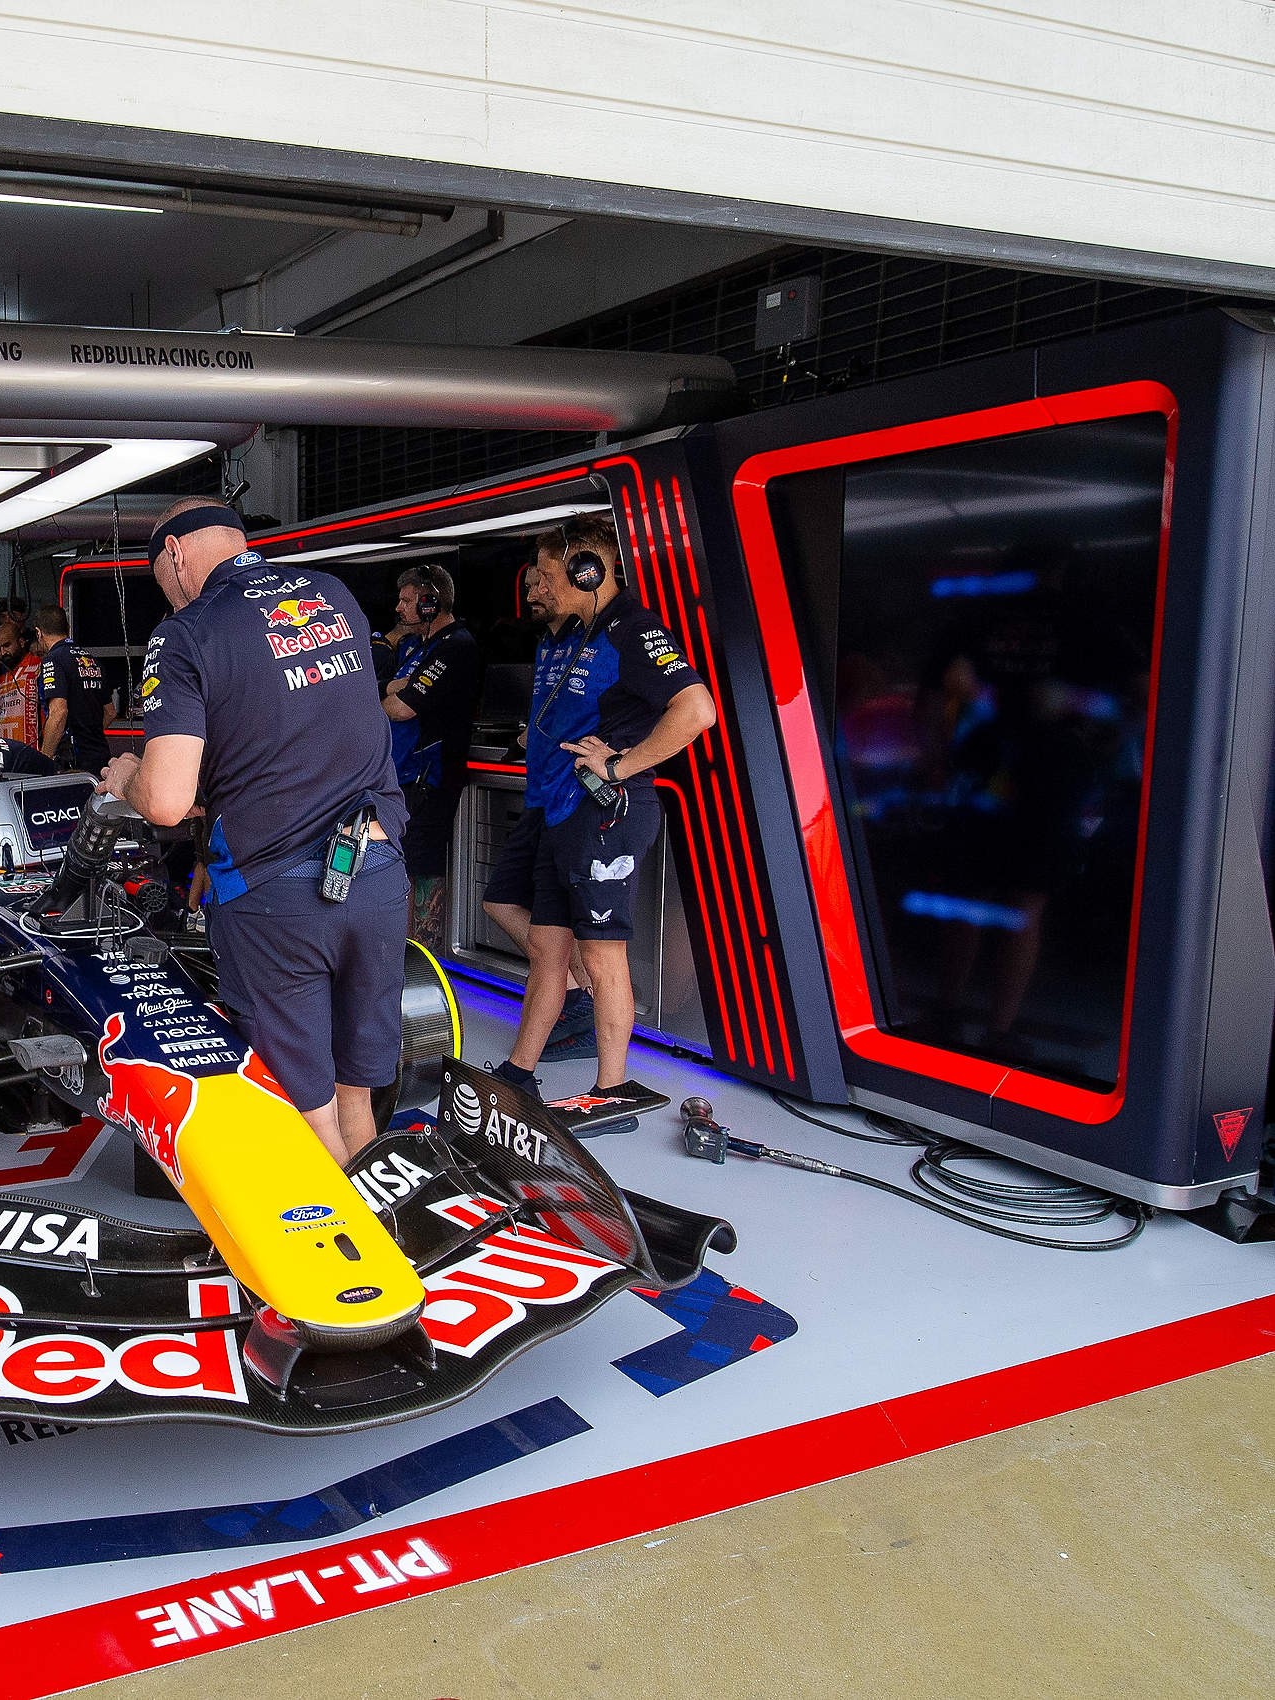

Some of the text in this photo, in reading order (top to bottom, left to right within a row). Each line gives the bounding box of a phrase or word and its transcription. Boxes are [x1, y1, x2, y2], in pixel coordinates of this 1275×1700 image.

[70, 343, 255, 371] REDBULLRACING.COM
[265, 612, 354, 660] Red Bull
[639, 629, 665, 641] VISA
[283, 653, 346, 691] Mobil
[31, 806, 82, 826] ORAC
[90, 950, 128, 962] VIS
[133, 971, 169, 982] AT&T
[121, 987, 185, 1001] TRADE
[132, 983, 168, 993] AVA
[135, 997, 193, 1018] Maui Jim
[142, 1014, 210, 1028] CARLYLE
[159, 1037, 228, 1055] PIRELLI
[168, 1052, 222, 1069] Mobil
[483, 1107, 549, 1166] AT&T
[349, 1150, 435, 1215] VISA
[135, 1537, 452, 1649] PIT-LANE
